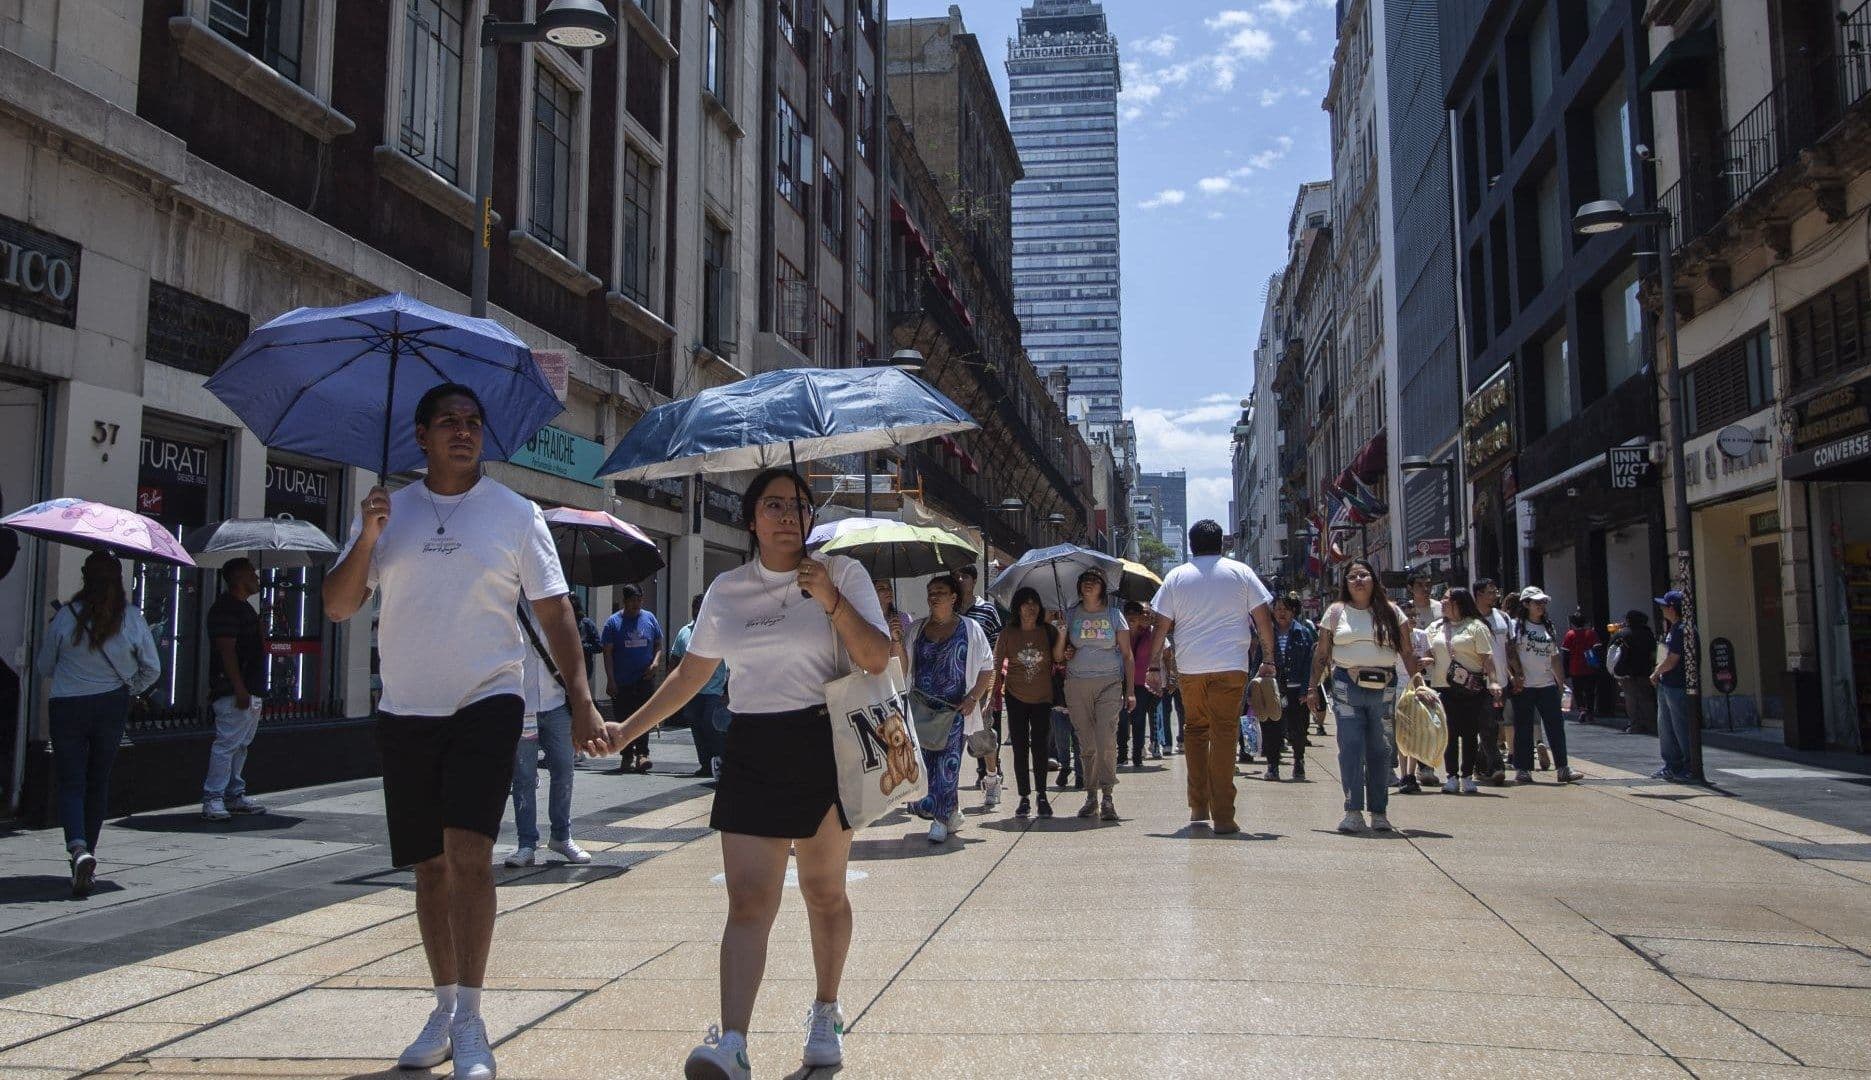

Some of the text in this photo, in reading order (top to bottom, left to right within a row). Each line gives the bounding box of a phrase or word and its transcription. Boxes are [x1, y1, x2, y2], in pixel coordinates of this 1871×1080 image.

[0, 241, 72, 300] ICO
[140, 437, 208, 476] TURATI
[1614, 450, 1641, 463] INN
[1814, 434, 1870, 467] CONVERSE
[275, 466, 328, 498] TURATI
[1615, 462, 1650, 476] VICT
[1616, 475, 1638, 489] US
